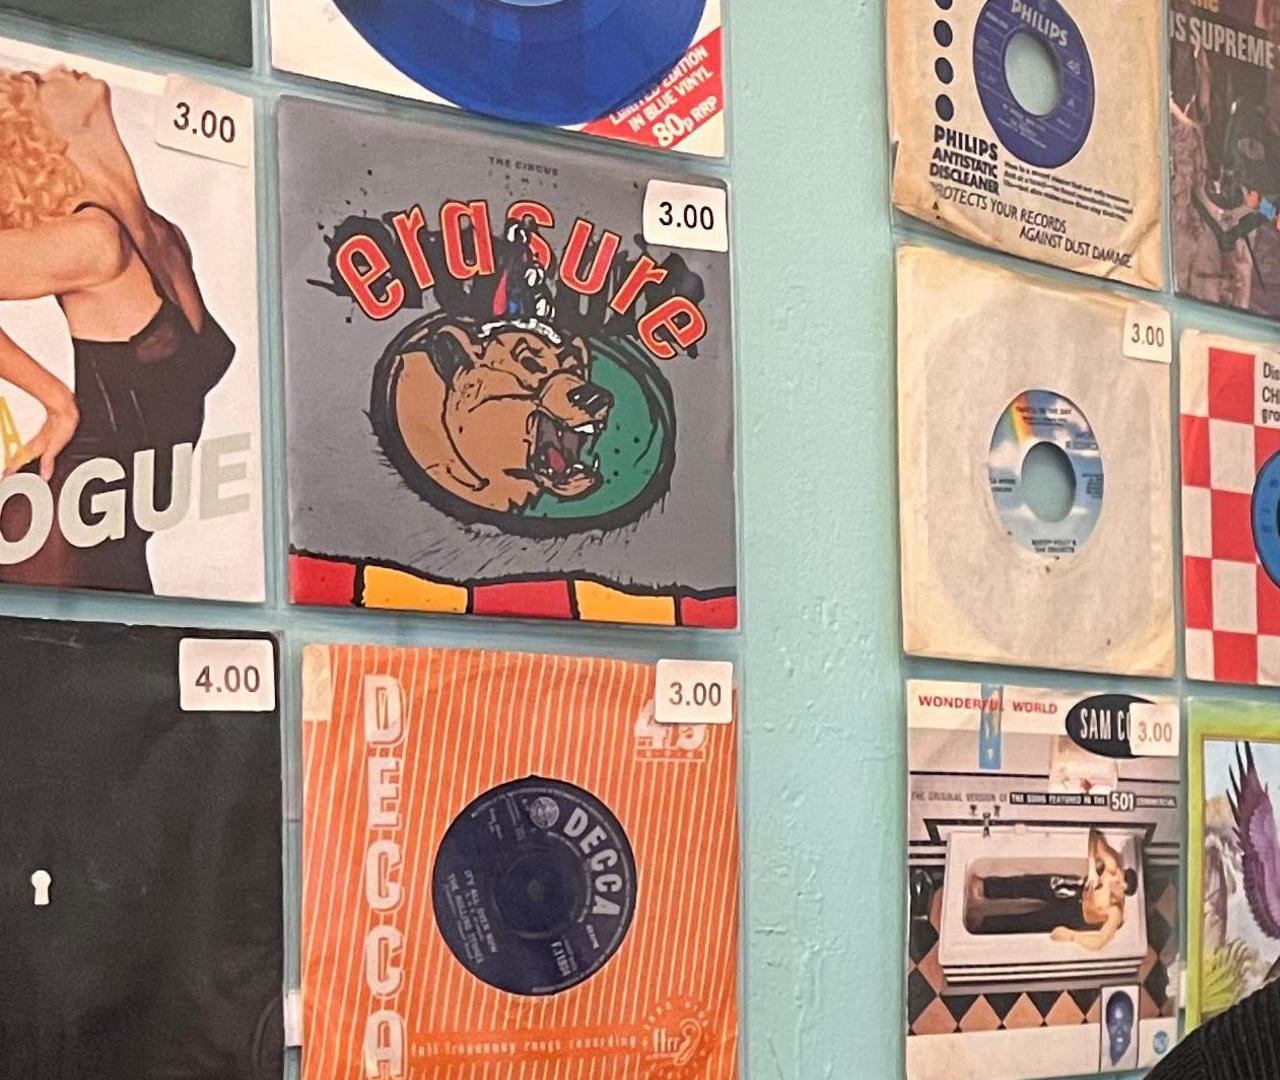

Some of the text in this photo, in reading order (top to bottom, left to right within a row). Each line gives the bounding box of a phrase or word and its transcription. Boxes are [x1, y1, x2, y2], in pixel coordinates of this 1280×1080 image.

[1011, 0, 1068, 47] PHILIPS
[1189, 17, 1275, 70] SUPREME
[627, 65, 713, 132] IN BLUE VINYL
[690, 95, 717, 122] RRP
[173, 102, 236, 144] 3.00
[934, 125, 998, 160] PHILIPS
[930, 163, 999, 195] DISCLEANER
[932, 147, 998, 179] ANTISTATIC
[658, 202, 714, 231] 3.00
[990, 199, 1018, 221] YOUR
[1020, 209, 1067, 234] RECORDS
[1019, 226, 1133, 268] AGAINST DUST DAMAGE
[335, 199, 708, 361] erasure
[1131, 323, 1166, 348] 3.00
[195, 665, 261, 693] 4.00
[669, 682, 721, 706] 3.00
[918, 695, 1058, 714] WONDERFUL WORLD
[1080, 708, 1112, 741] SAM
[1138, 721, 1173, 743] 3.00
[1112, 794, 1135, 811] 501
[563, 806, 622, 915] DECCA
